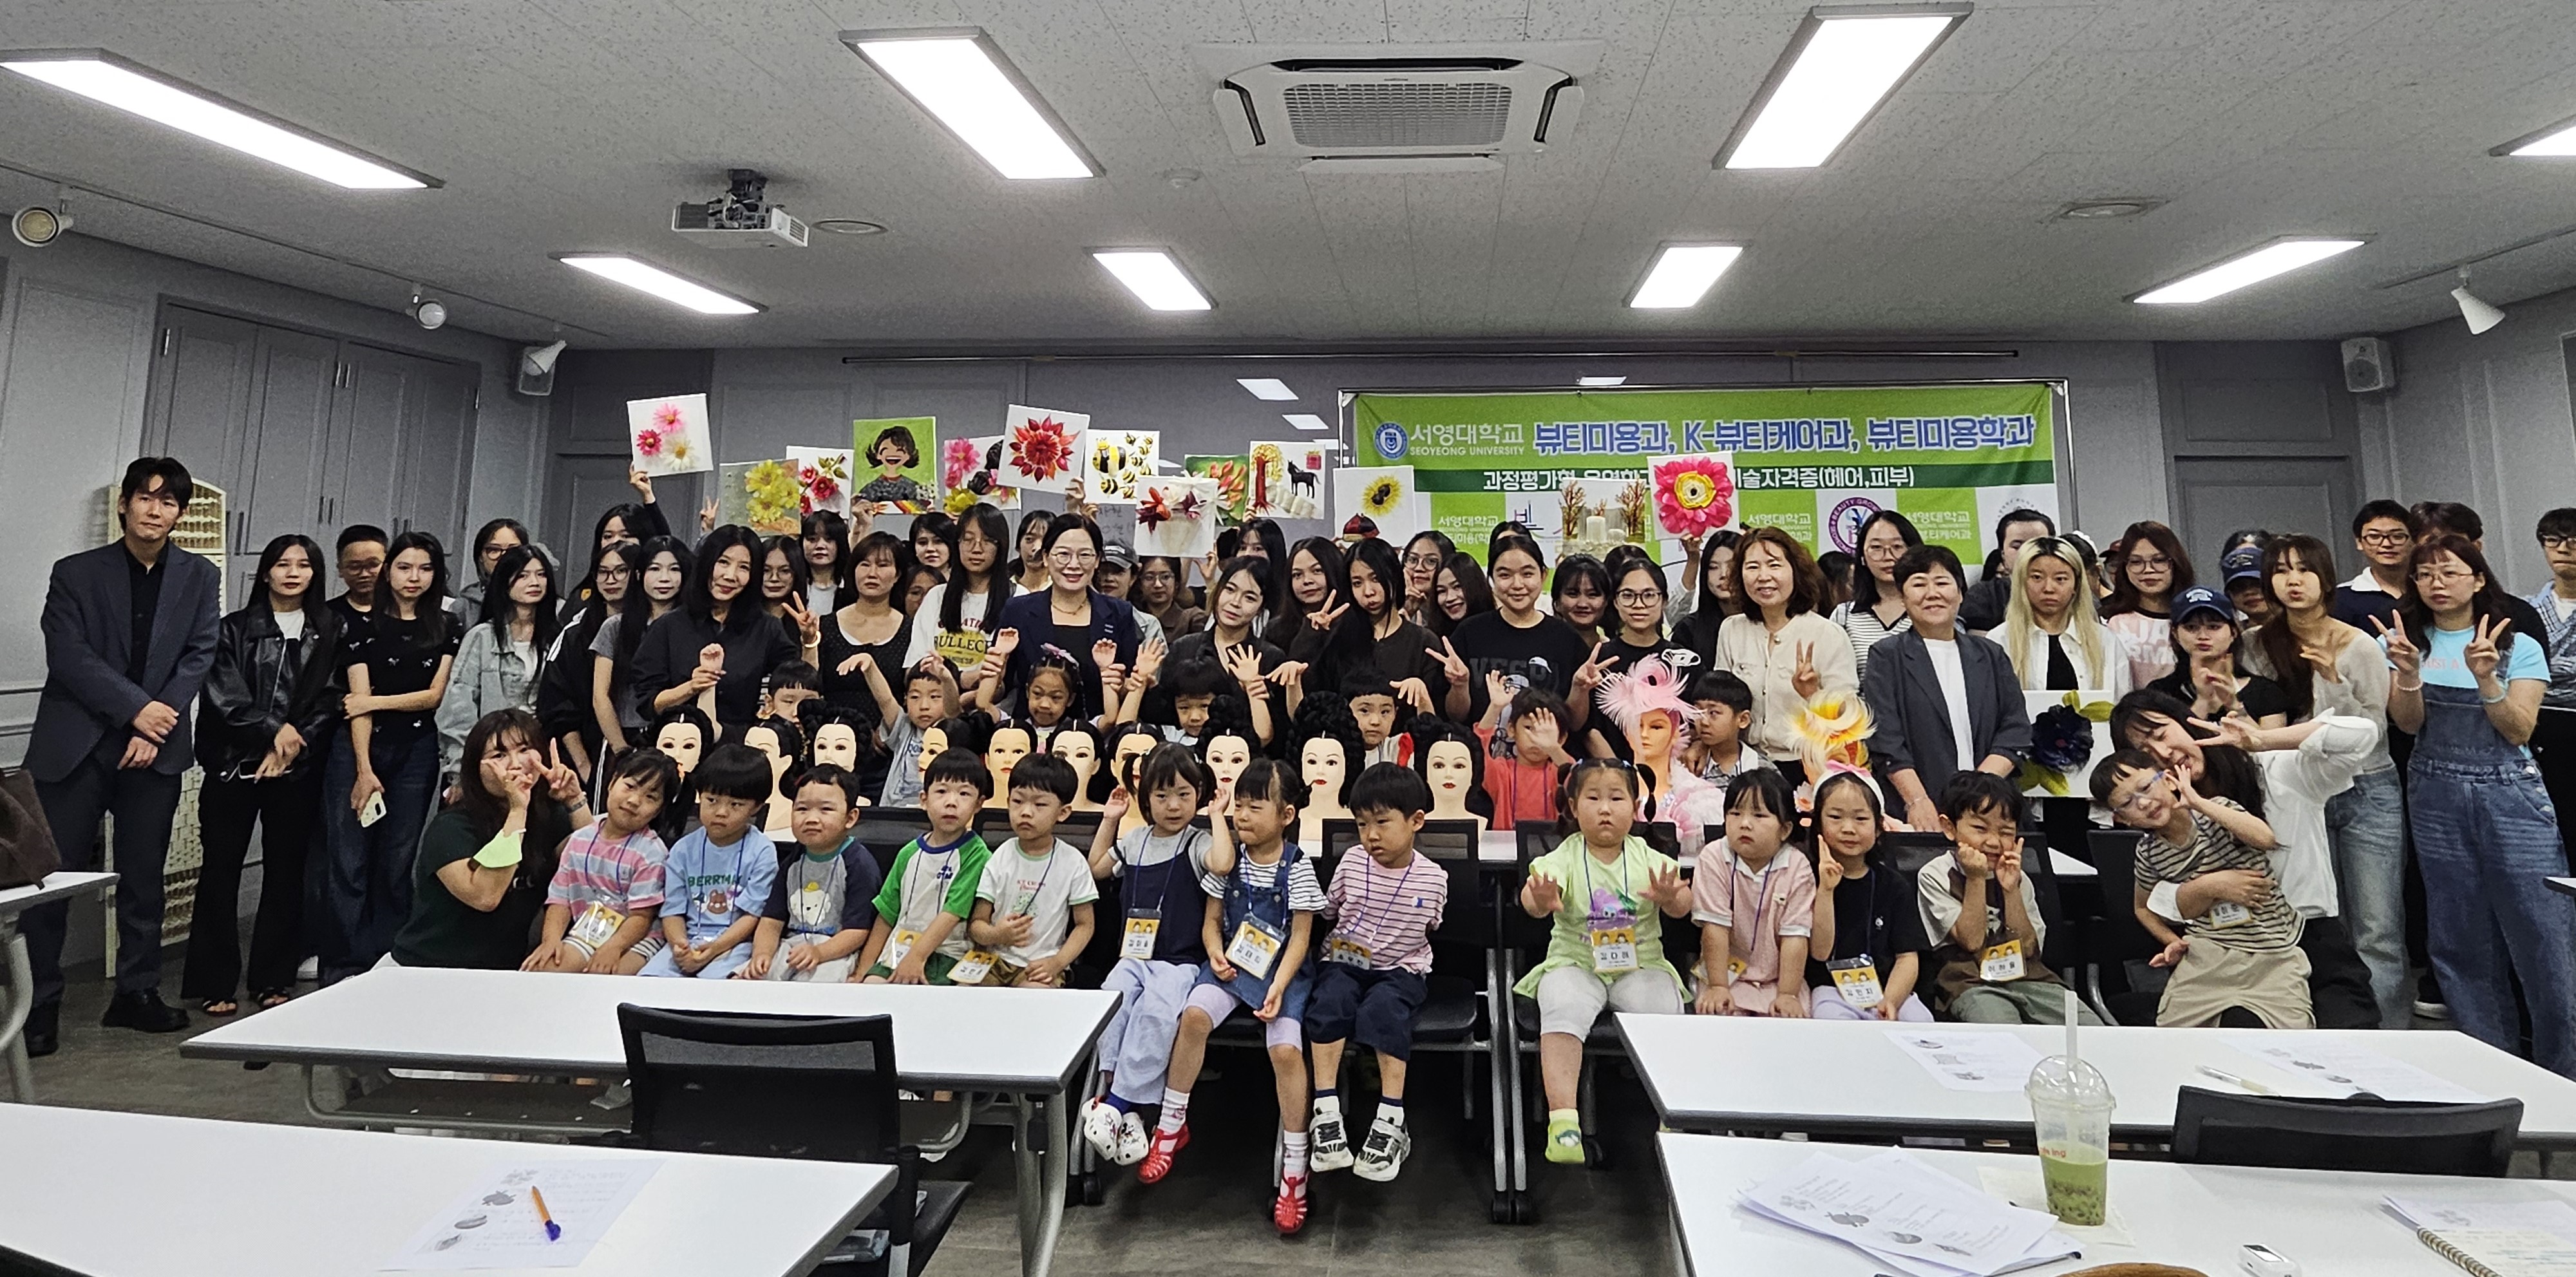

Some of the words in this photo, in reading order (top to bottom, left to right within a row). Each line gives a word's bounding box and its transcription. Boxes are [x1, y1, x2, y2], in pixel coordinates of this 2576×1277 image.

[1410, 423, 1524, 446] 서영대학교
[1534, 421, 1676, 455] 뷰티미용과,
[1684, 419, 1859, 452] K-뷰티케어과,
[1868, 415, 2034, 450] 뷰티미용학과
[1410, 446, 1466, 456] SEOYEONG
[1469, 446, 1525, 456] UNIVERSITY
[1734, 466, 1915, 489] 술자격증(헤어,피부)
[1438, 515, 1499, 527] 서영대학교
[1748, 513, 1812, 525] 서영대학교
[1906, 511, 1971, 523] 서영대학교
